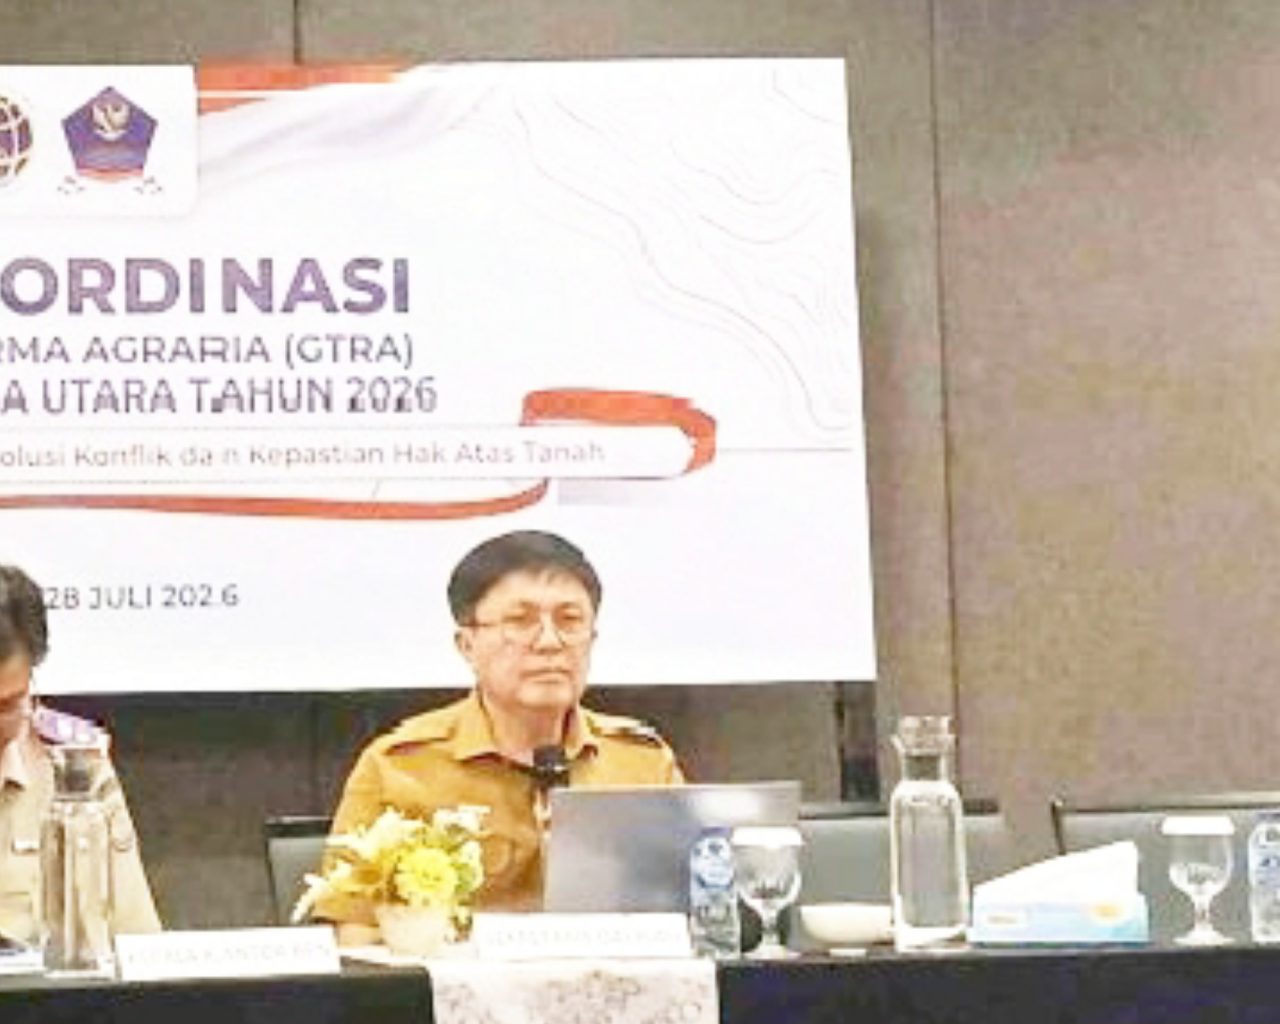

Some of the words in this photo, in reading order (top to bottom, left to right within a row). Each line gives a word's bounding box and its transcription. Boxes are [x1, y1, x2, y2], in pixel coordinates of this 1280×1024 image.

[82, 335, 272, 366] AGRARIA
[283, 332, 415, 372] (GTRA)
[41, 377, 178, 416] UTARA
[187, 377, 334, 415] TAHUN
[346, 375, 438, 415] 2026
[74, 444, 173, 468] Konflik
[249, 443, 385, 472] Kepastian
[393, 443, 448, 466] Hak
[455, 443, 516, 464] Atas
[523, 440, 607, 463] Tanah
[45, 586, 81, 610] 28
[89, 585, 153, 611] JULI
[161, 583, 240, 608] 2026
